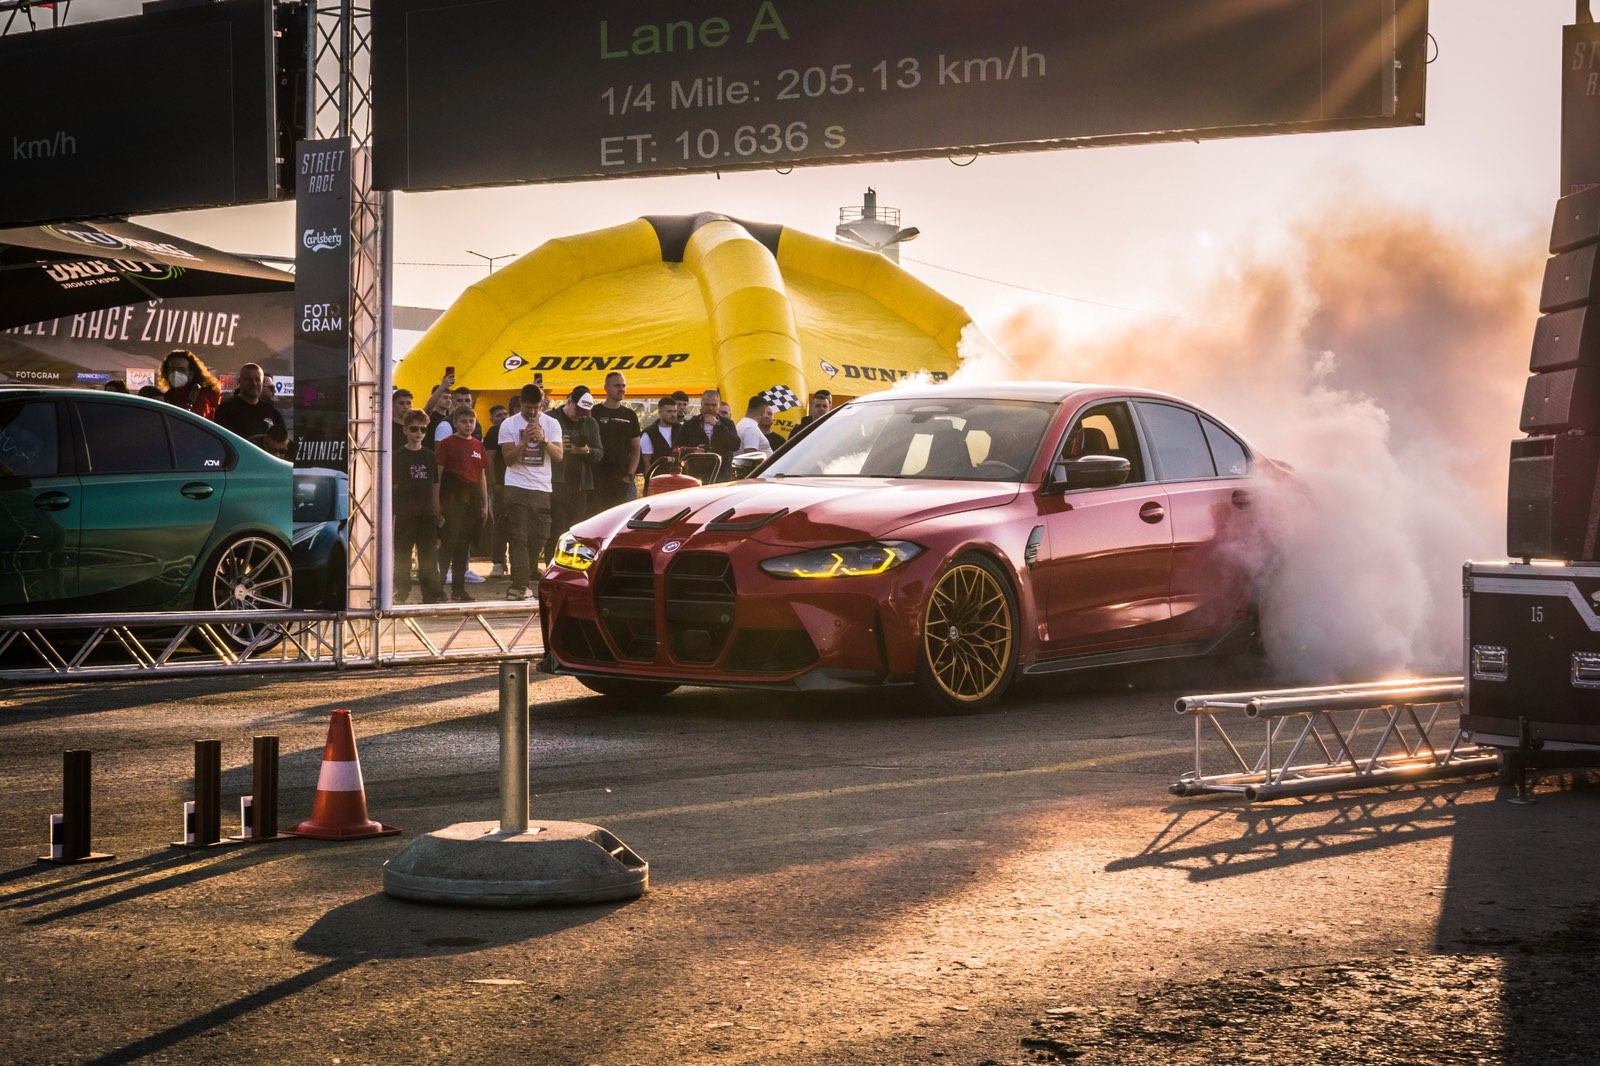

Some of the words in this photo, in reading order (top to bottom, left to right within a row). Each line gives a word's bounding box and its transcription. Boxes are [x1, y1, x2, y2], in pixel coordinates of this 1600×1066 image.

[599, 15, 731, 60] Lane
[746, 1, 790, 44] A
[600, 83, 655, 116] 1/4
[671, 74, 761, 110] Mile:
[777, 56, 921, 100] 205.13
[938, 46, 1047, 85] km/h
[13, 131, 77, 160] km/h
[600, 133, 657, 167] ET:
[675, 121, 809, 160] 10.636
[824, 124, 846, 149] s
[301, 150, 344, 175] STREET
[308, 174, 335, 193] RACE
[303, 227, 342, 249] Carlsberg
[70, 306, 135, 341] RACE
[141, 298, 241, 347] ŽIVINICE
[302, 317, 342, 332] GRAM
[530, 353, 690, 370] DUNLOP
[842, 364, 948, 382] DUNP
[15, 370, 60, 379] FOTOGRAM
[296, 436, 345, 461] ŽIVINICE
[1530, 606, 1543, 622] 15
